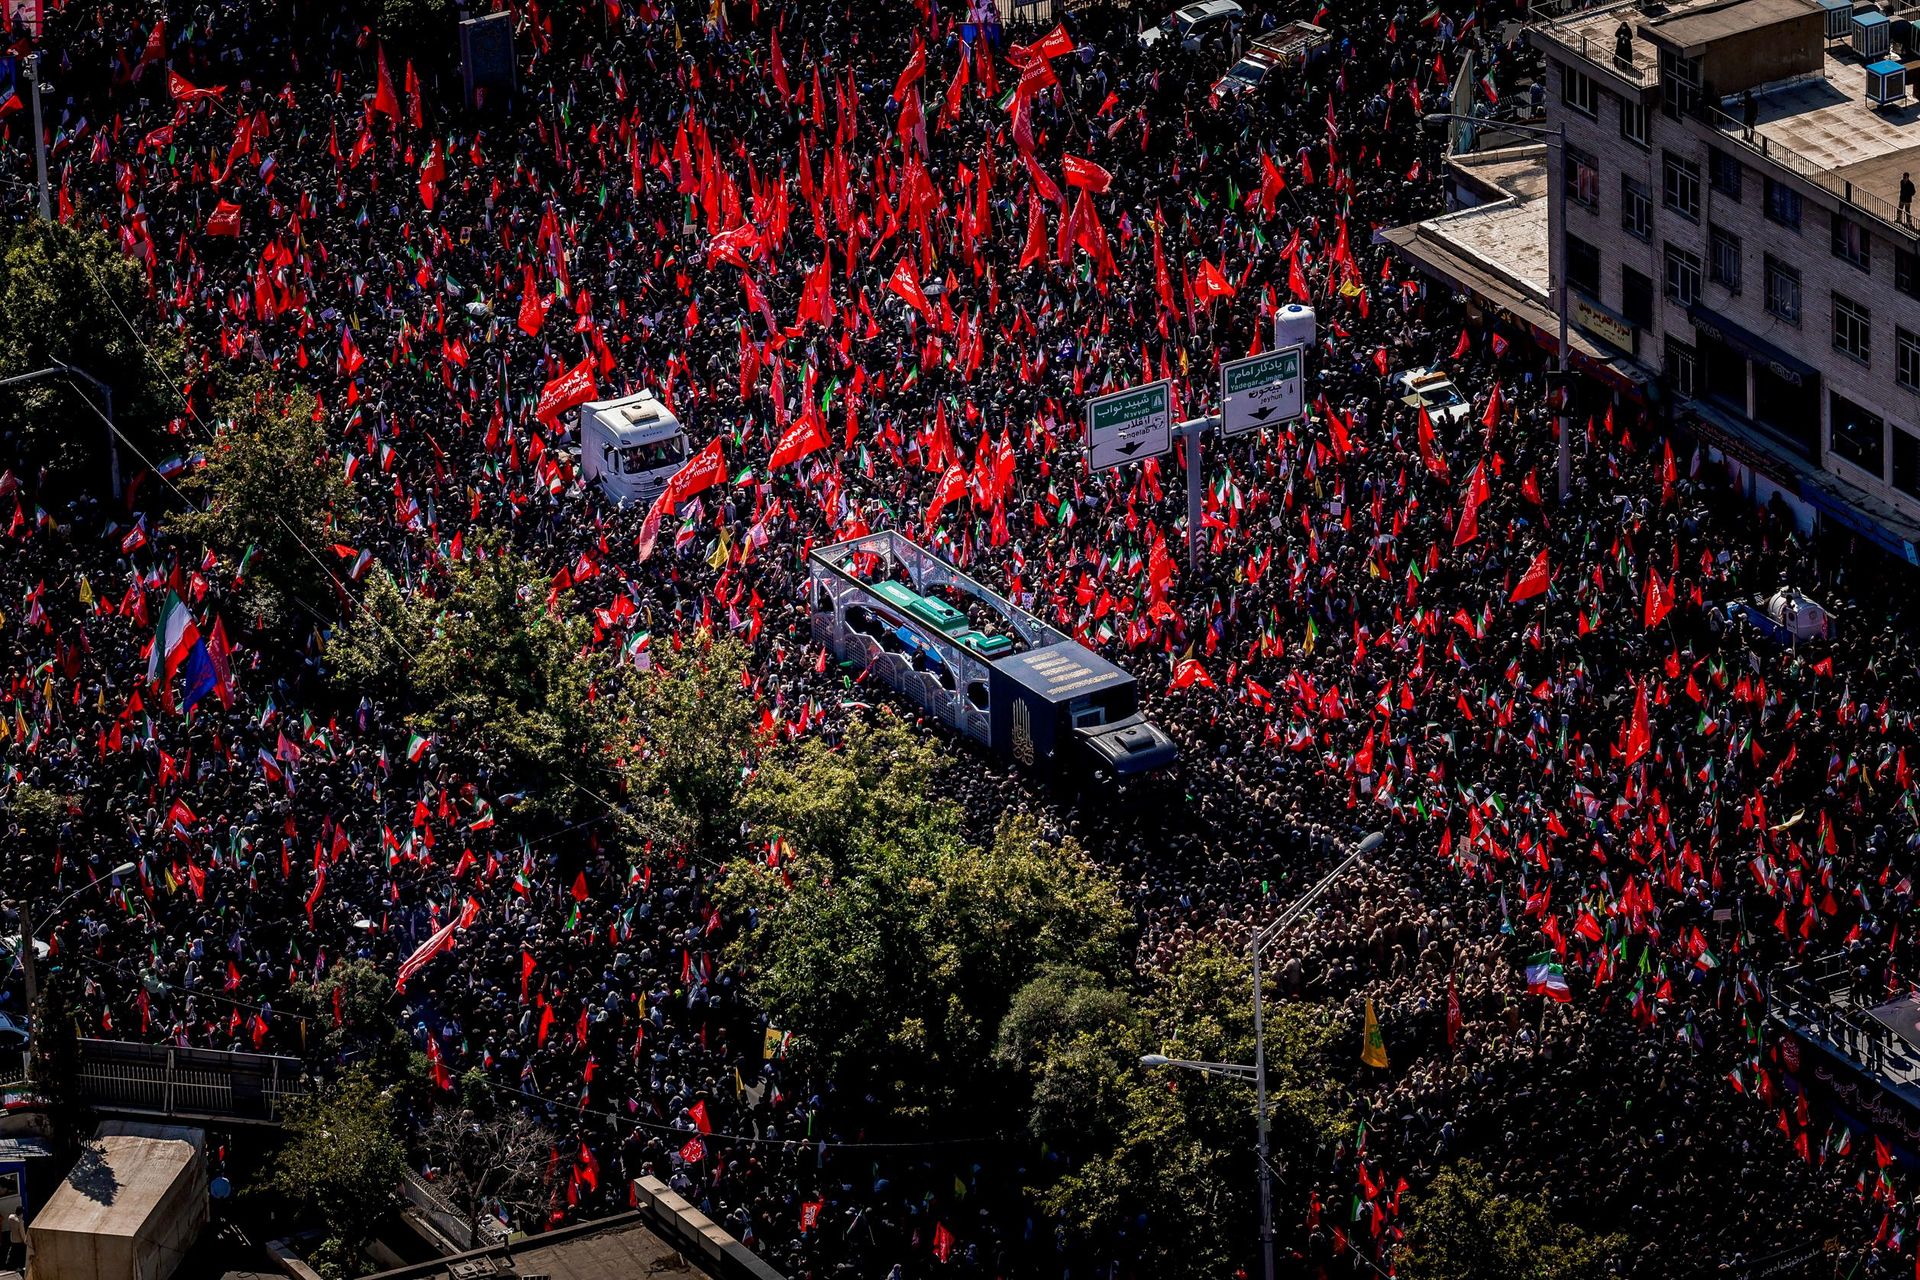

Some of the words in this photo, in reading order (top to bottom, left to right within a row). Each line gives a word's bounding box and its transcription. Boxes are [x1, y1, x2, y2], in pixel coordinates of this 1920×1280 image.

[1234, 366, 1253, 384] امام
[1254, 360, 1282, 377] یادگار
[1125, 393, 1150, 409] شهید
[1097, 402, 1122, 418] نواب
[1118, 416, 1150, 432] انقلاب
